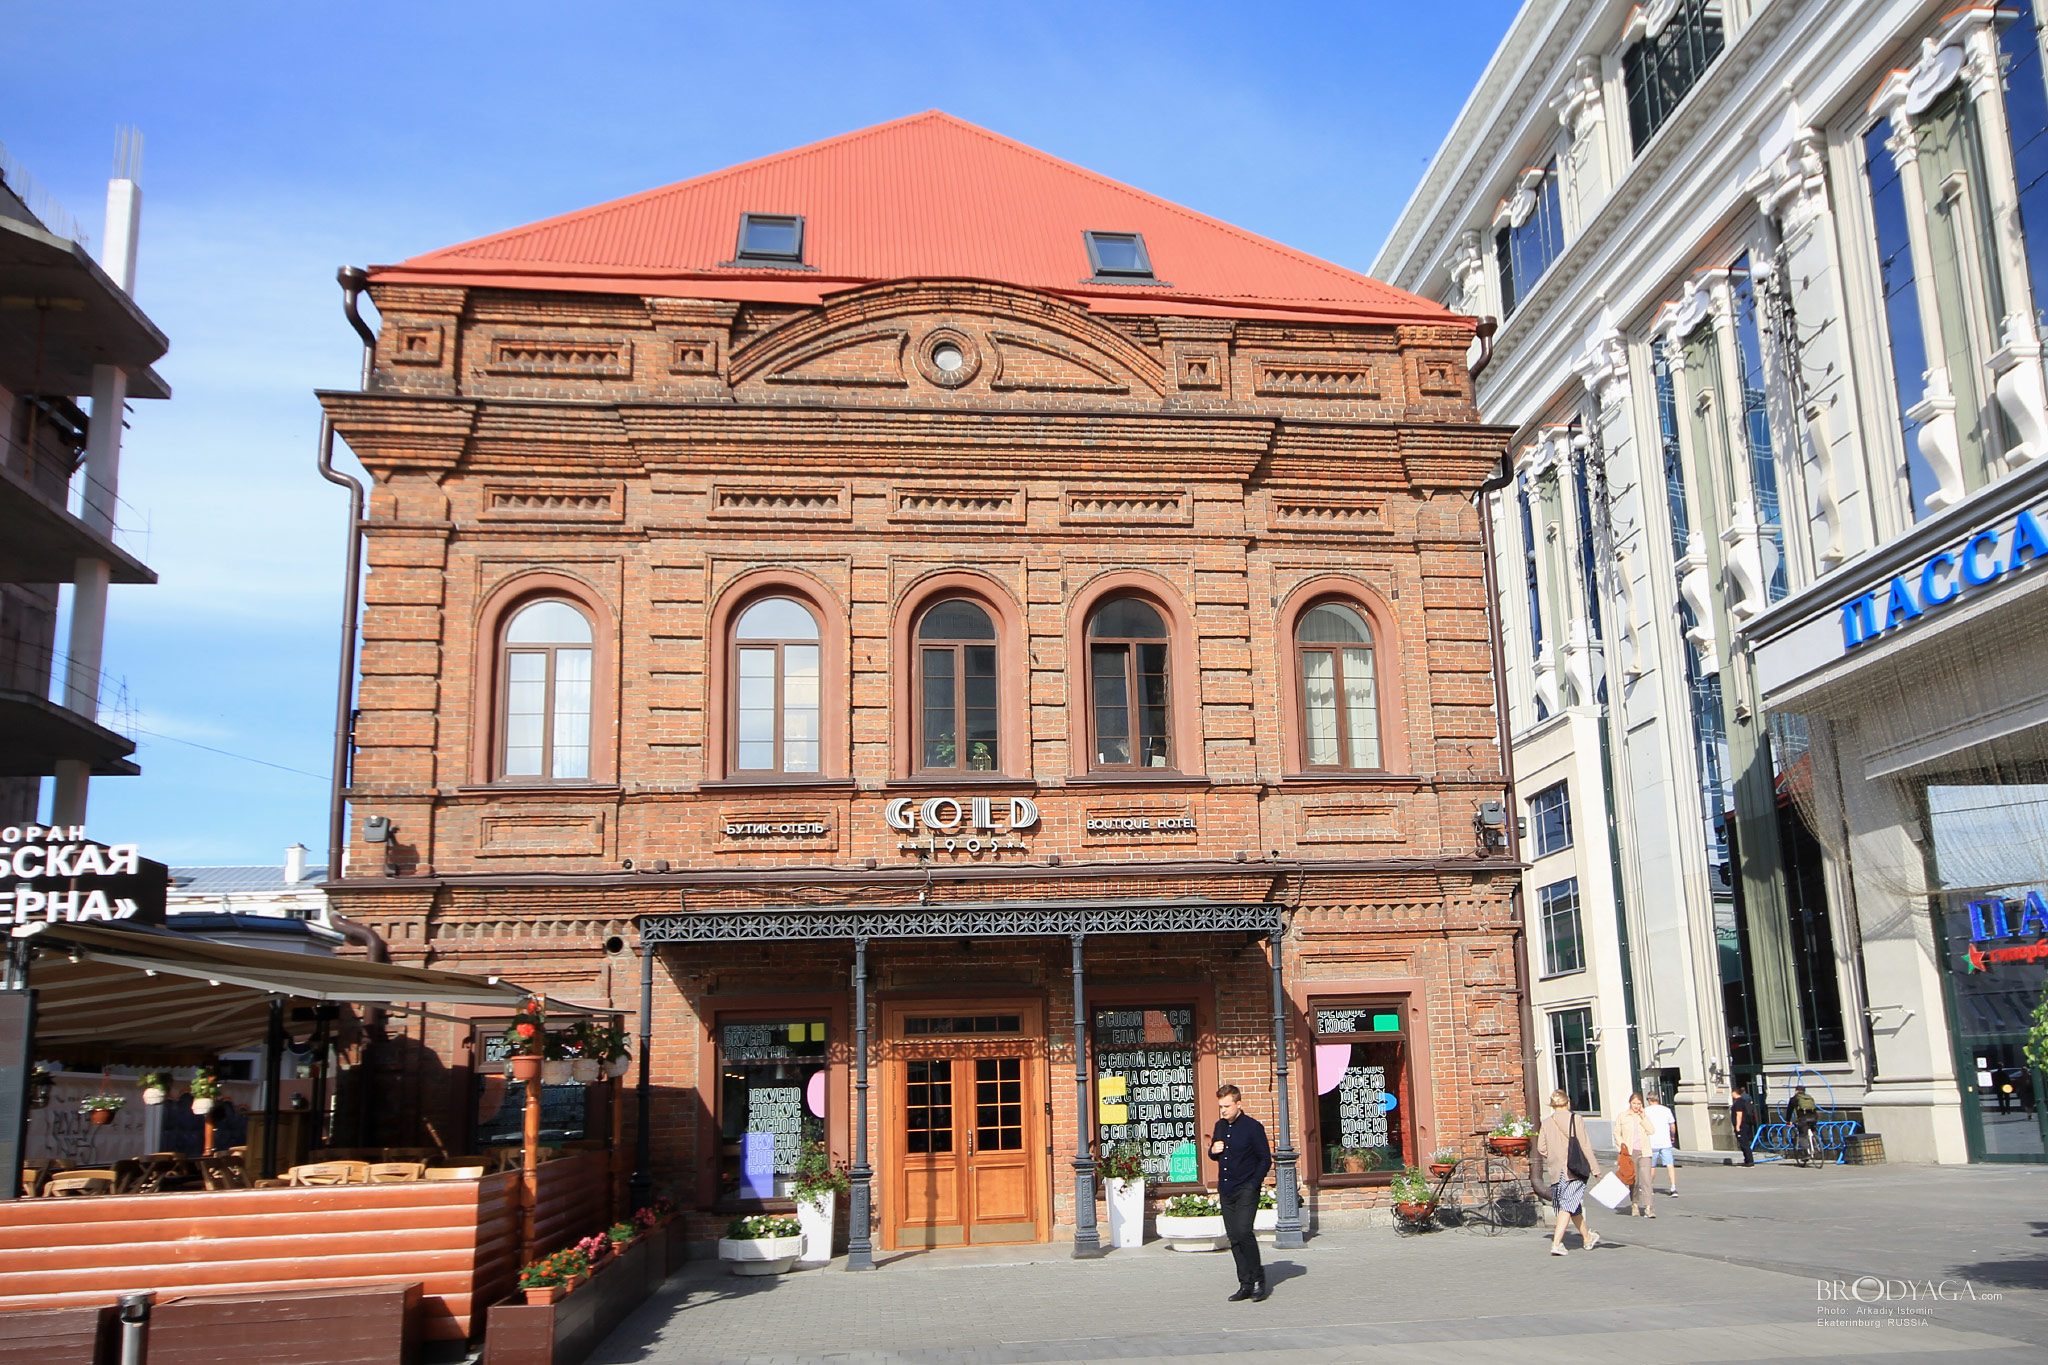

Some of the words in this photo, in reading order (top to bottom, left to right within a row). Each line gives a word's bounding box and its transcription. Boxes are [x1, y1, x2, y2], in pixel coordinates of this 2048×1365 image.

[885, 797, 1038, 829] GOLD
[1086, 819, 1150, 831] BOUTIQUE
[1157, 818, 1198, 829] HOTEL
[2, 825, 86, 843] ОРАН
[928, 838, 999, 854] 1905
[1169, 1010, 1179, 1025] С
[1325, 1018, 1356, 1033] КОФЕ
[724, 1031, 772, 1046] ВКУСНО
[1112, 1029, 1137, 1044] ЕДА
[1137, 1028, 1145, 1044] С
[1098, 1053, 1107, 1069] С
[1108, 1050, 1146, 1068] СОБОЙ
[1147, 1052, 1172, 1069] ЕДА
[1172, 1051, 1181, 1067] С
[1150, 1066, 1187, 1084] СОБОЙ
[1133, 1083, 1170, 1102] СОБОЙ
[1339, 1089, 1360, 1104] ФЕ
[1359, 1088, 1386, 1104] КОФ
[1138, 1104, 1163, 1121] ЕДА
[1163, 1103, 1172, 1119] С
[1100, 1125, 1109, 1140] С
[1110, 1121, 1148, 1139] СОБОЙ
[1150, 1122, 1174, 1139] ЕДА
[1175, 1122, 1184, 1137] С
[1340, 1118, 1372, 1134] КОФЕ
[1153, 1137, 1190, 1155] СОБОЙ
[1141, 1154, 1173, 1174] ОБОЙ
